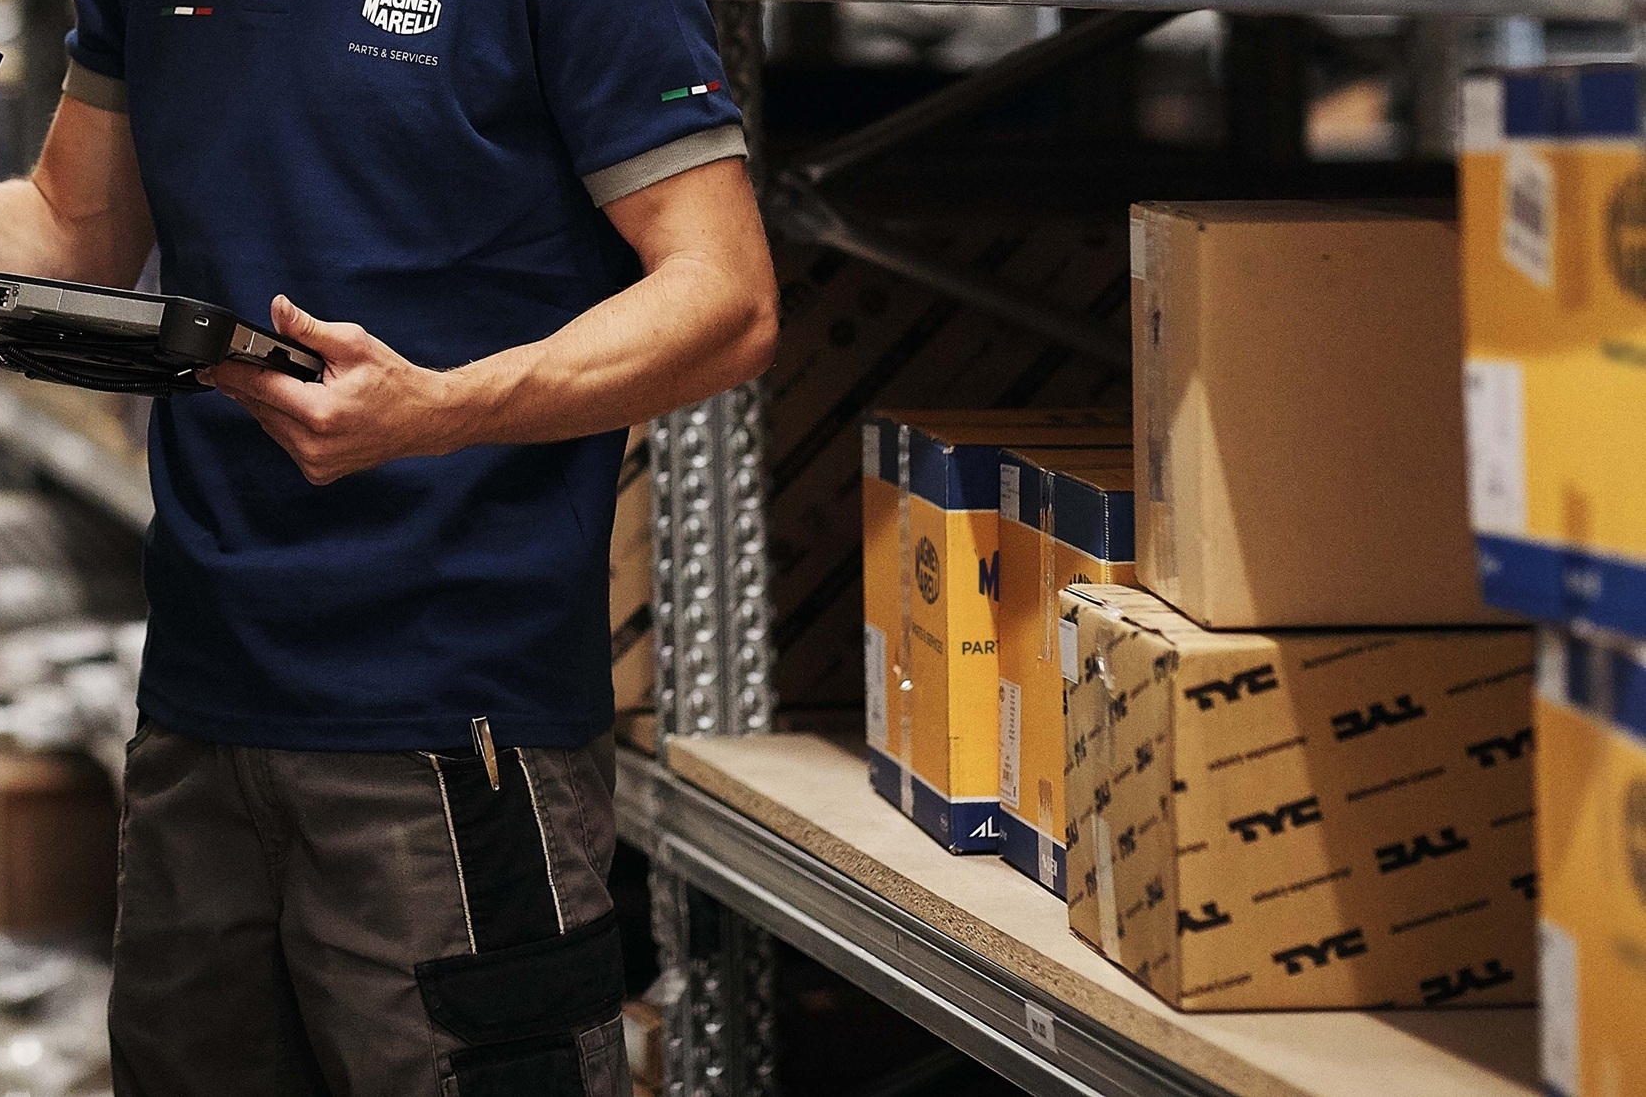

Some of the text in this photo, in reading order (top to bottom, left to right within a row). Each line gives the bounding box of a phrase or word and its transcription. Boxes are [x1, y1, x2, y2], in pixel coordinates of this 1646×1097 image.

[361, 1, 442, 35] MARELLI
[348, 42, 439, 66] PARTS & SERVICES
[962, 640, 999, 655] PAR
[1185, 664, 1279, 711] TYC
[1465, 726, 1534, 769] TY
[1228, 796, 1323, 843] TYC
[1272, 928, 1368, 976] TYC
